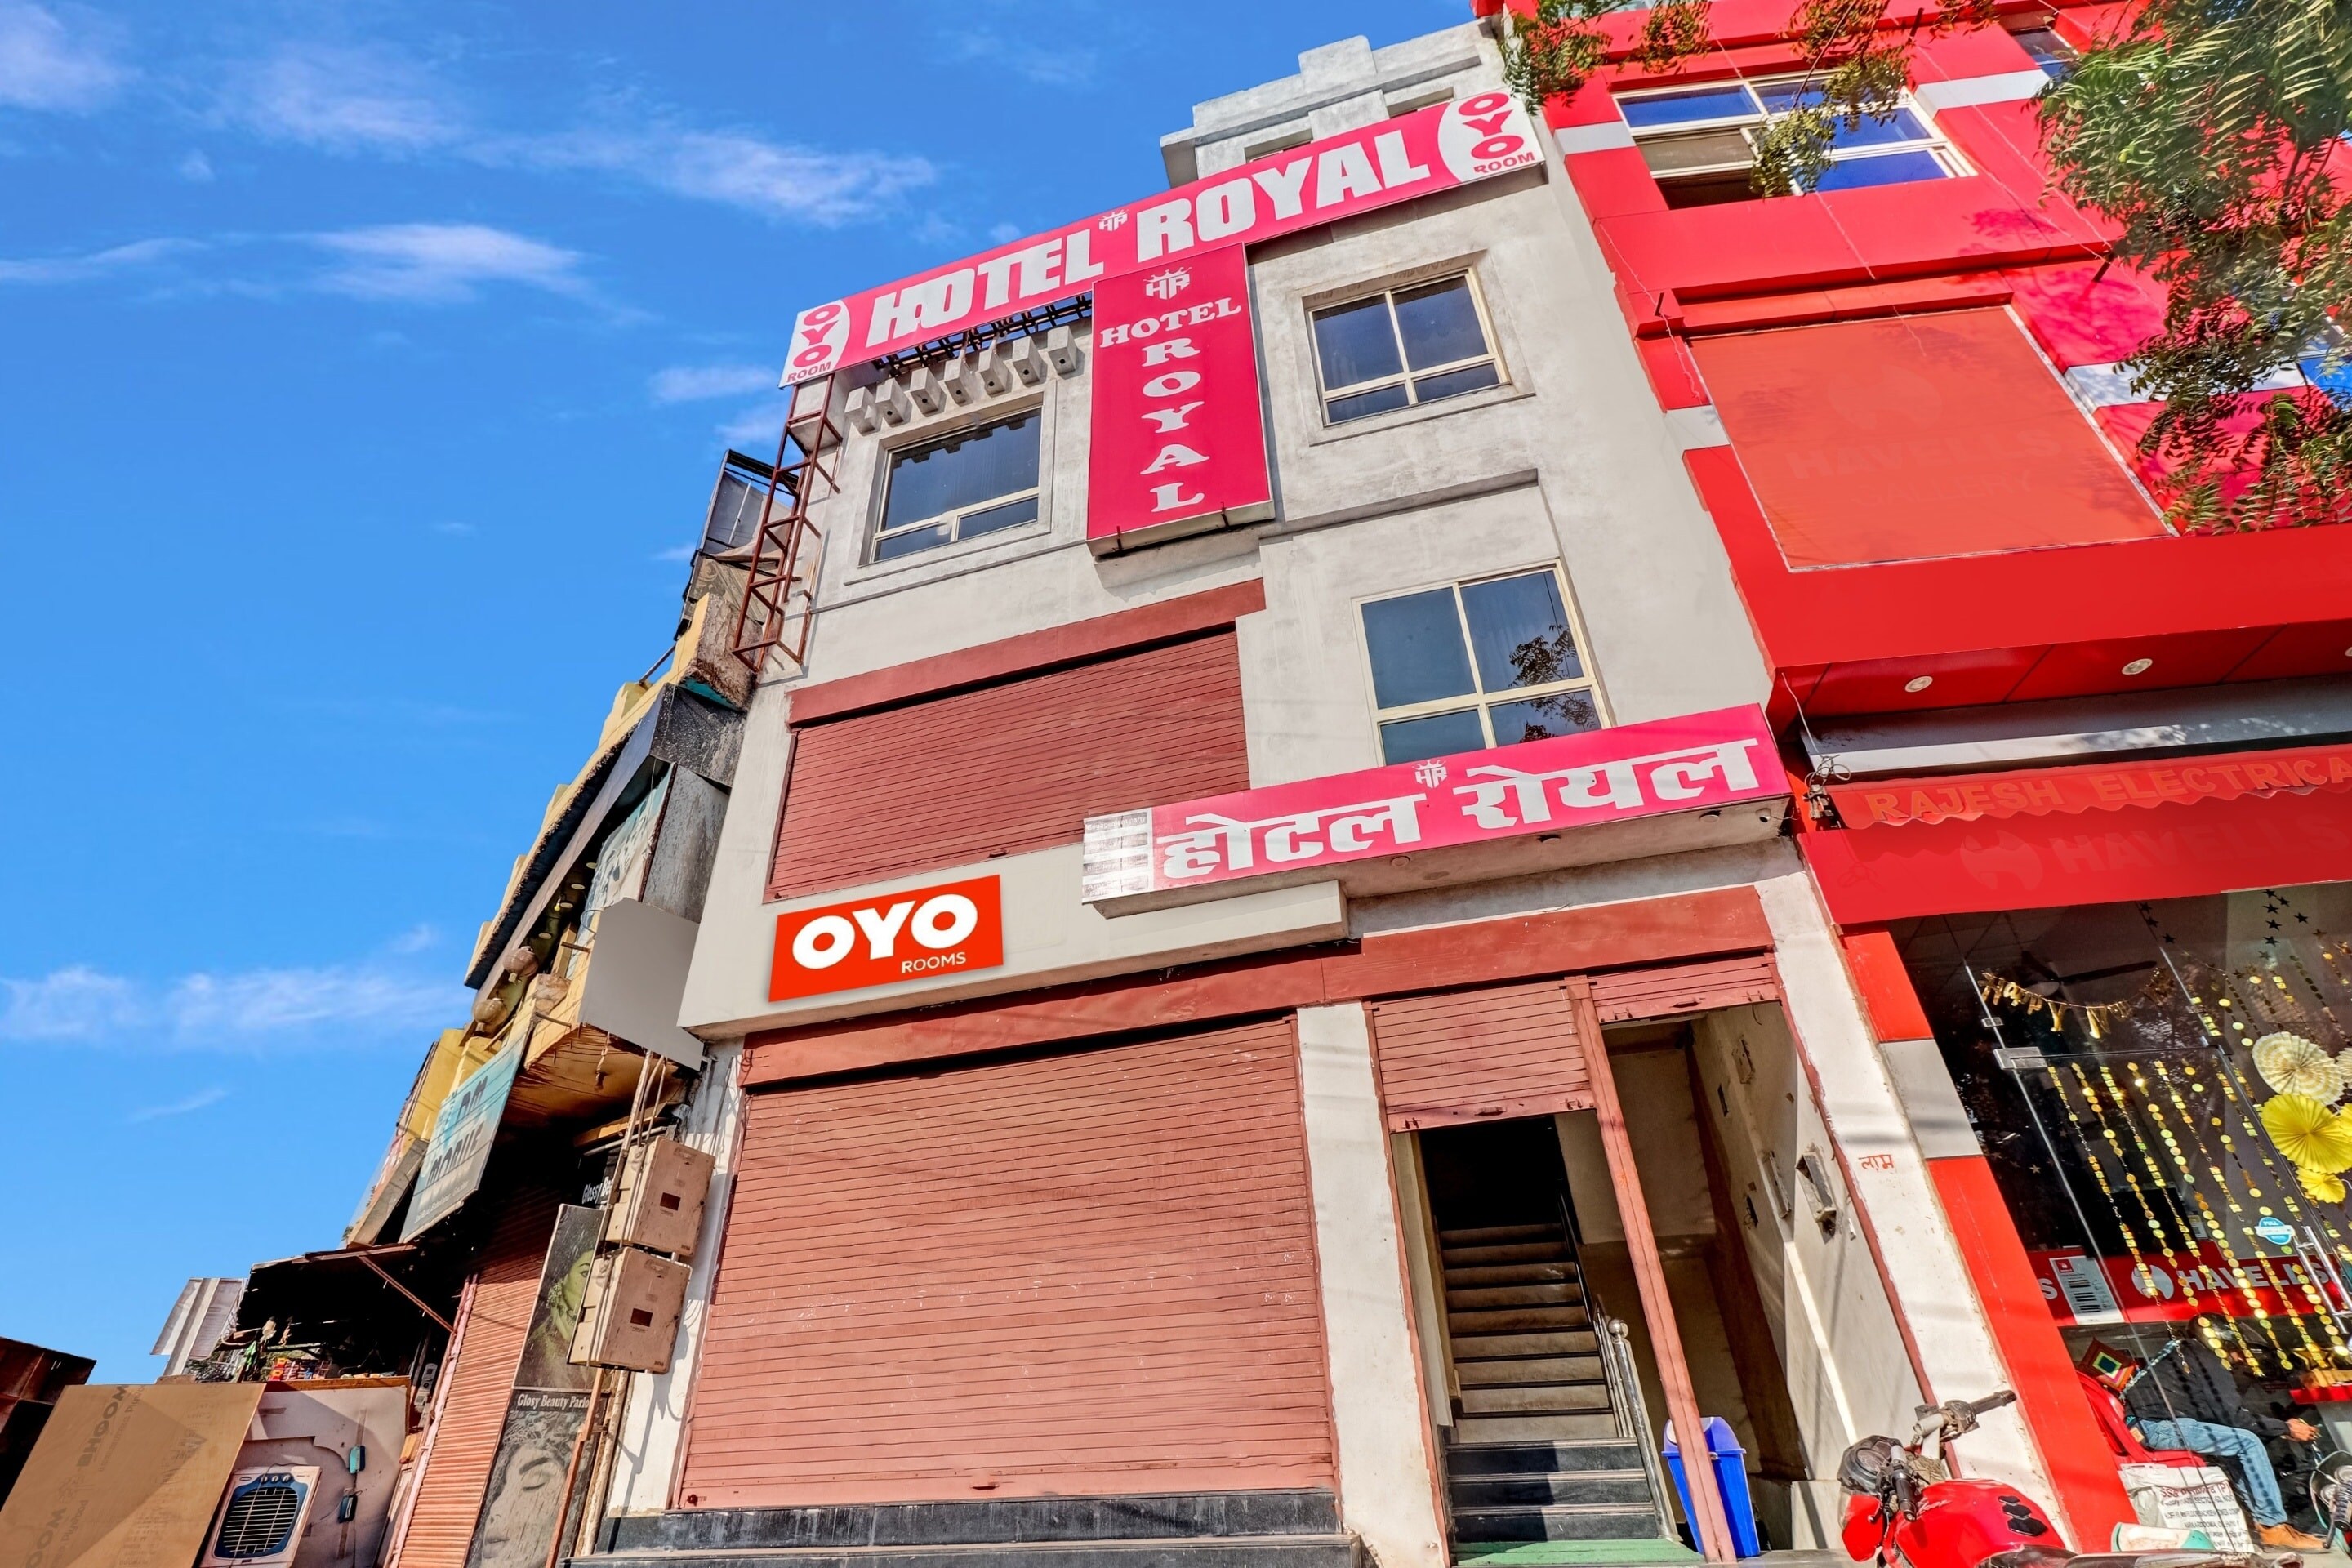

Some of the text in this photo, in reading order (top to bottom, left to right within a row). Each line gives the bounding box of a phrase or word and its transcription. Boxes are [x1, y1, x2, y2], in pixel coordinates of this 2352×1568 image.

[1458, 92, 1525, 159] OYO
[1473, 151, 1535, 174] ROOM
[866, 129, 1431, 349] HOTEL ROYAL
[793, 303, 842, 368] OYO
[1099, 296, 1242, 349] HOTEL
[786, 361, 832, 383] ROOM
[1139, 336, 1210, 513] ROYAL
[1156, 737, 1759, 879] होटल रोयल
[1864, 757, 2352, 822] RAJESH ELECTRICA
[791, 893, 979, 970] OYO
[900, 951, 967, 976] ROOMS
[2177, 1263, 2330, 1290] HAVELLS
[518, 1393, 590, 1410] Glosy Beauty Parlo
